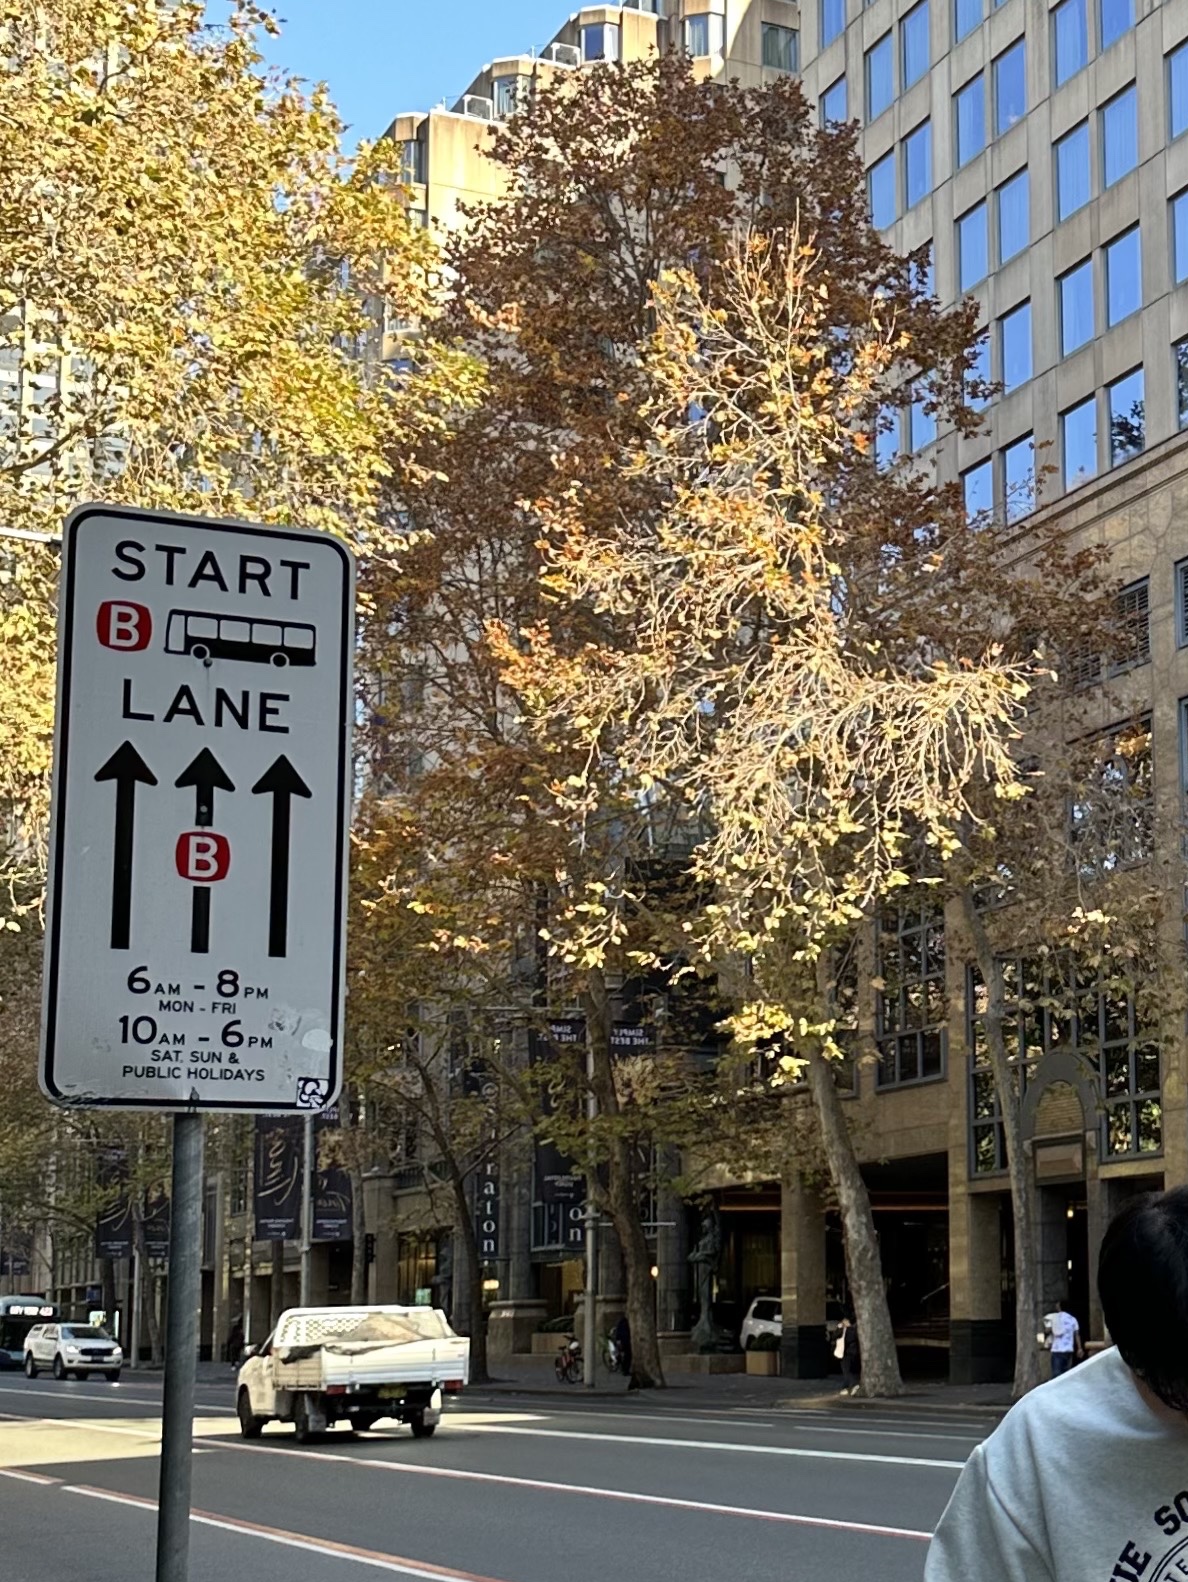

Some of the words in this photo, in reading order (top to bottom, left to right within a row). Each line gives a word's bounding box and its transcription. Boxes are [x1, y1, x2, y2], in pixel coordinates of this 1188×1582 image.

[111, 539, 311, 600] START
[121, 677, 291, 735] LANE
[127, 965, 181, 996] 6AM
[216, 969, 269, 999] 8PM
[158, 1000, 195, 1013] MON
[211, 1001, 237, 1014] FRI
[118, 1014, 186, 1046] 10AM
[221, 1019, 273, 1049] 6PM
[122, 1065, 181, 1080] PUBLIC
[187, 1067, 265, 1082] HOLIDAYS
[189, 1050, 222, 1064] SUN
[228, 1052, 240, 1065] &
